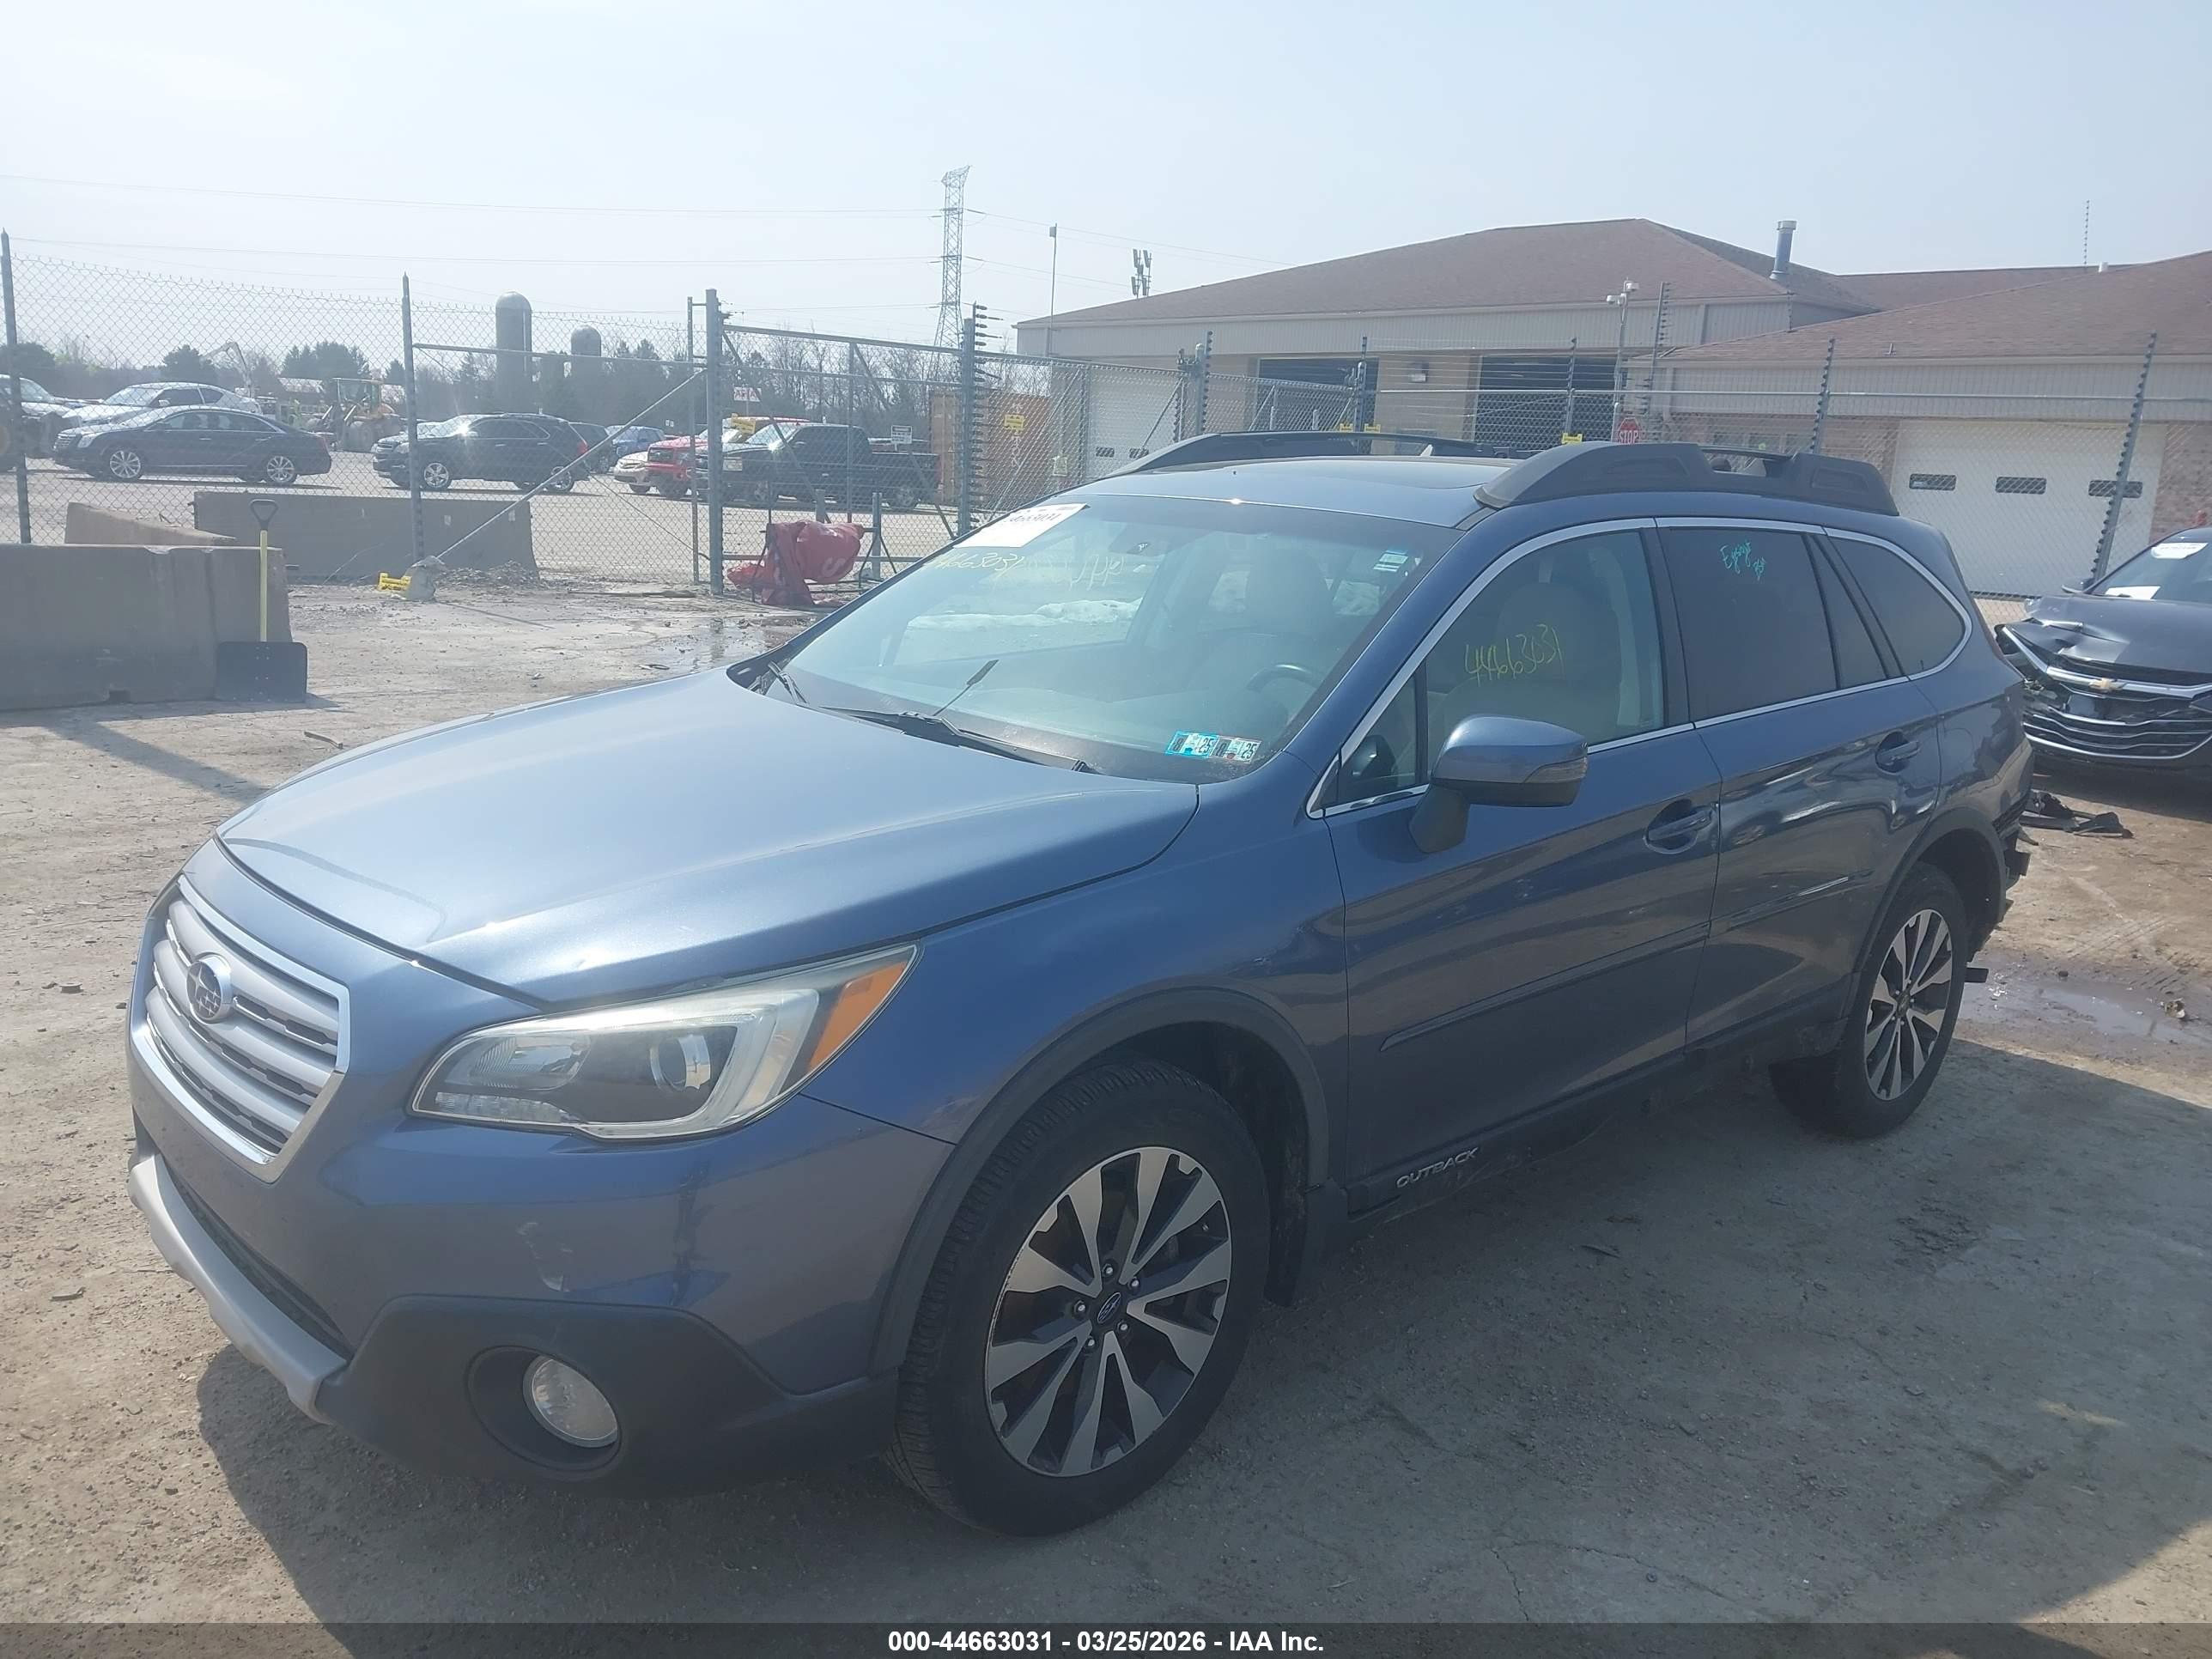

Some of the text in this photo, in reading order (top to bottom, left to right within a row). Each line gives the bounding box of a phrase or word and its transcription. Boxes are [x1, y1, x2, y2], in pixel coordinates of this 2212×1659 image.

[1620, 430, 1638, 444] STOP
[1199, 738, 1215, 754] 25
[1241, 743, 1257, 760] 25
[1396, 1147, 1479, 1188] OUTBACK
